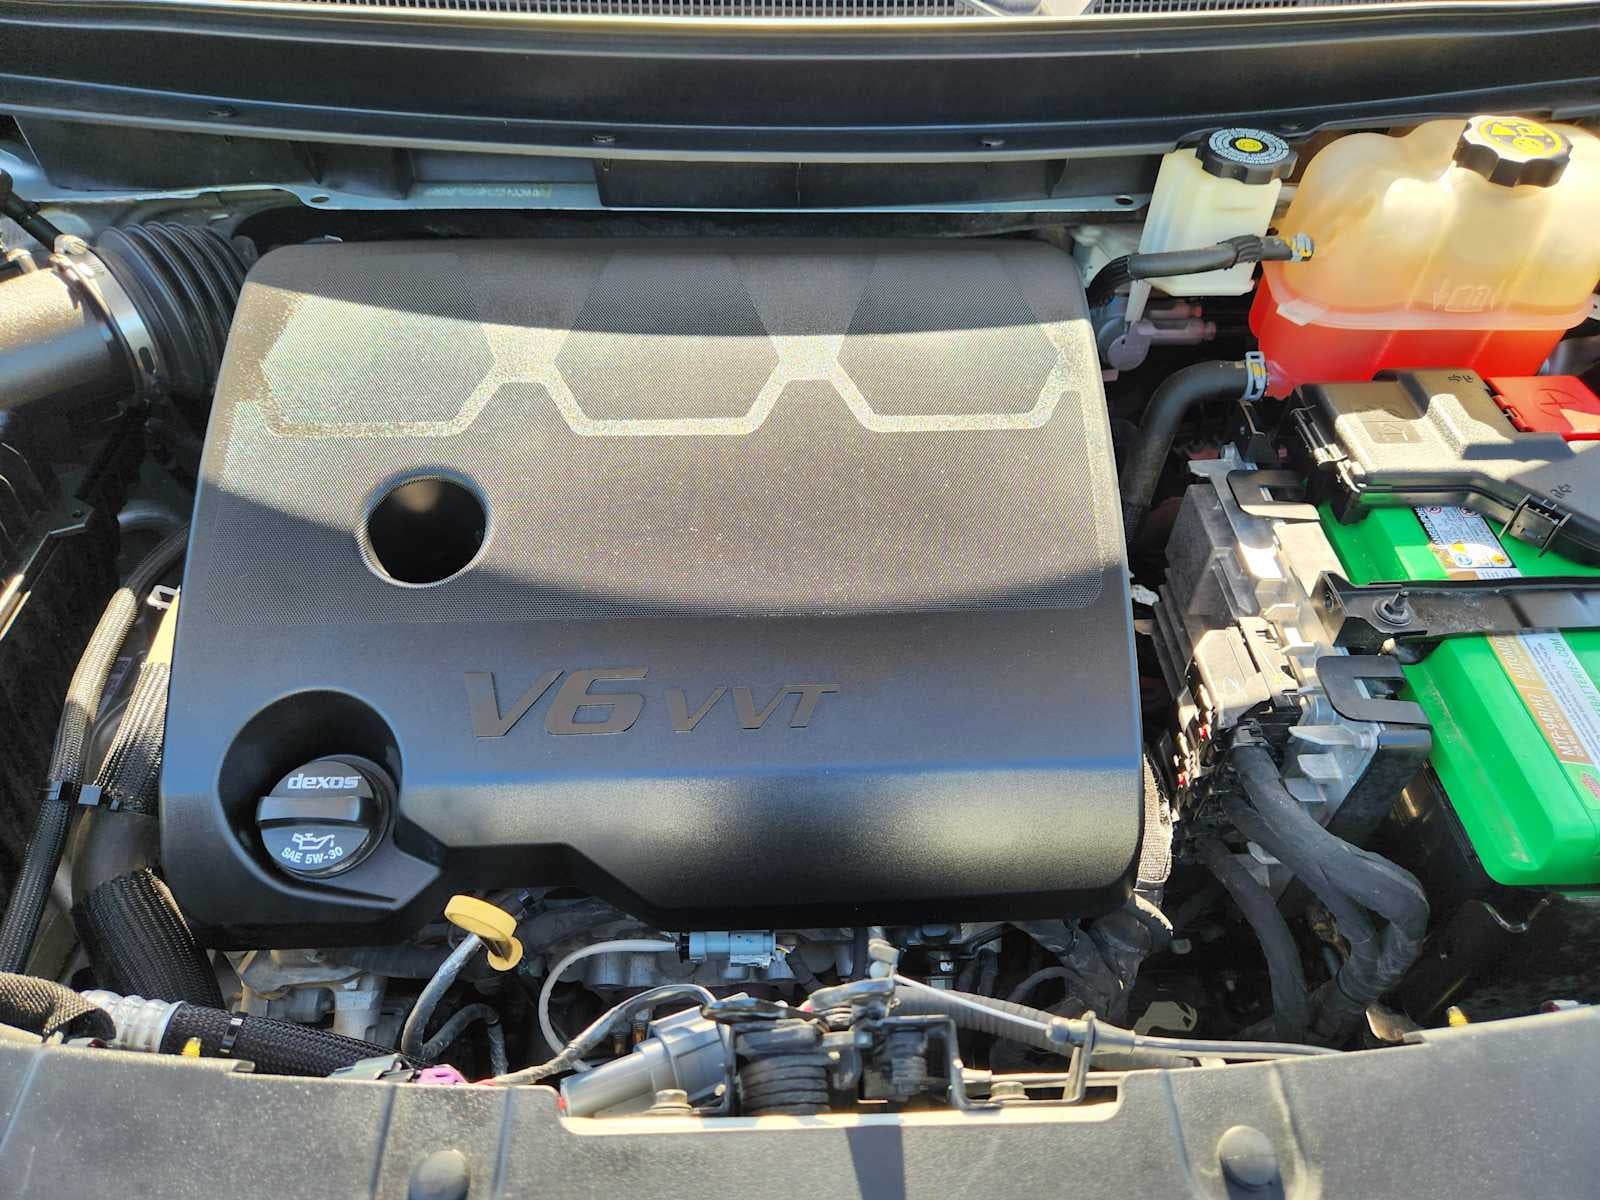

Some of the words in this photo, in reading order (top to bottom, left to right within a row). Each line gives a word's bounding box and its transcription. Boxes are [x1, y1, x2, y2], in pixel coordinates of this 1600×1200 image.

[464, 666, 649, 739] V6
[664, 682, 841, 733] VVT
[287, 773, 361, 789] dexos
[281, 847, 303, 863] SAE
[305, 846, 343, 864] 5W-30
